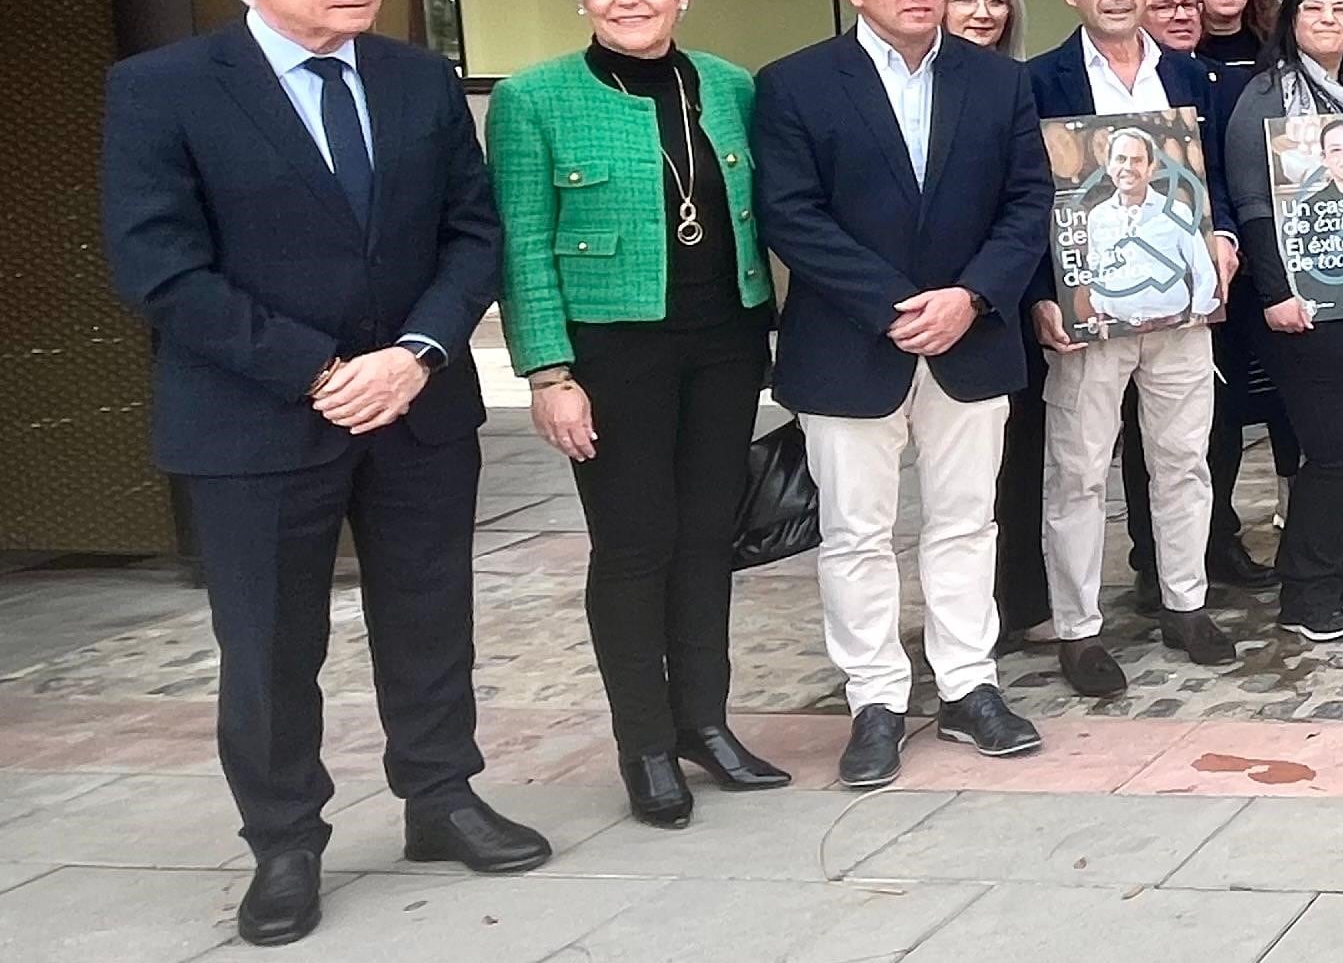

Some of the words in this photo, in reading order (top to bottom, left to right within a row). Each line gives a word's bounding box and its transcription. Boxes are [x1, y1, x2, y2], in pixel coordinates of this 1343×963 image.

[1055, 208, 1087, 227] Un
[1282, 200, 1310, 217] Un
[1283, 217, 1310, 236] de
[1058, 227, 1087, 246] de
[1285, 238, 1304, 256] El
[1061, 249, 1082, 270] El
[1287, 254, 1313, 272] de
[1063, 267, 1093, 286] de
